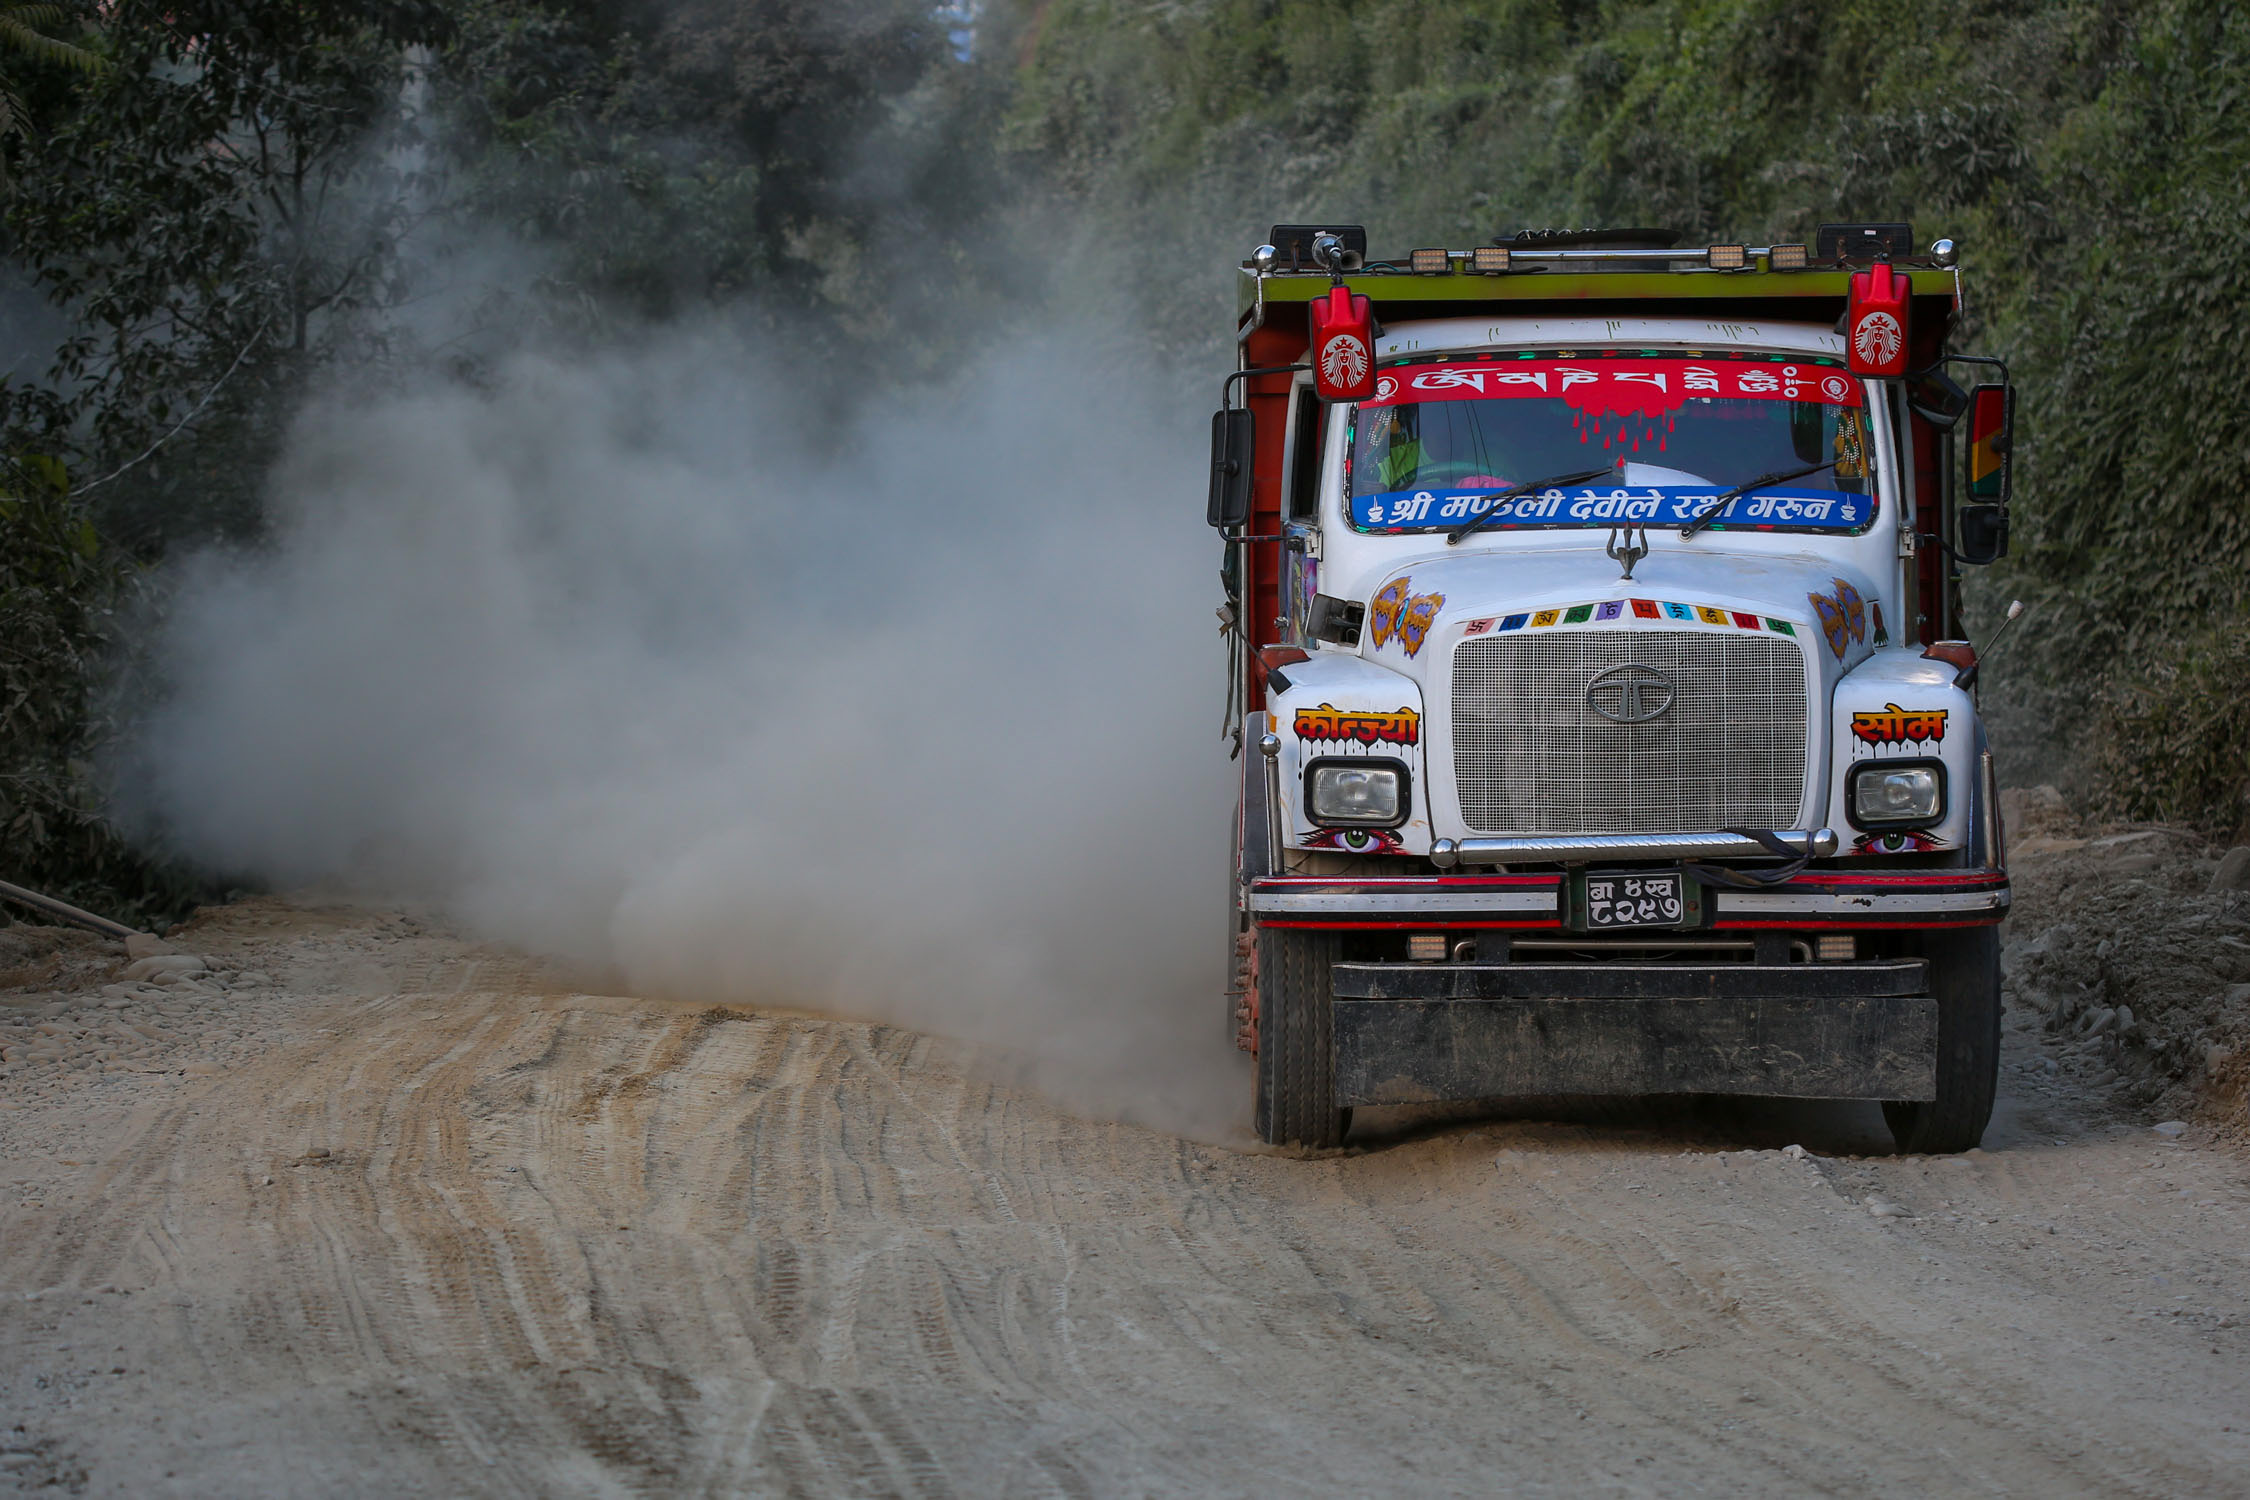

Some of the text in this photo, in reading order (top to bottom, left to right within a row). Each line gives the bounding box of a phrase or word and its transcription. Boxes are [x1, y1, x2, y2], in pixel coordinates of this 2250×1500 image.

[1387, 491, 1436, 525] श्री
[1569, 489, 1666, 520] देवीले
[1850, 702, 1948, 745] सोम
[1589, 882, 1615, 900] बा
